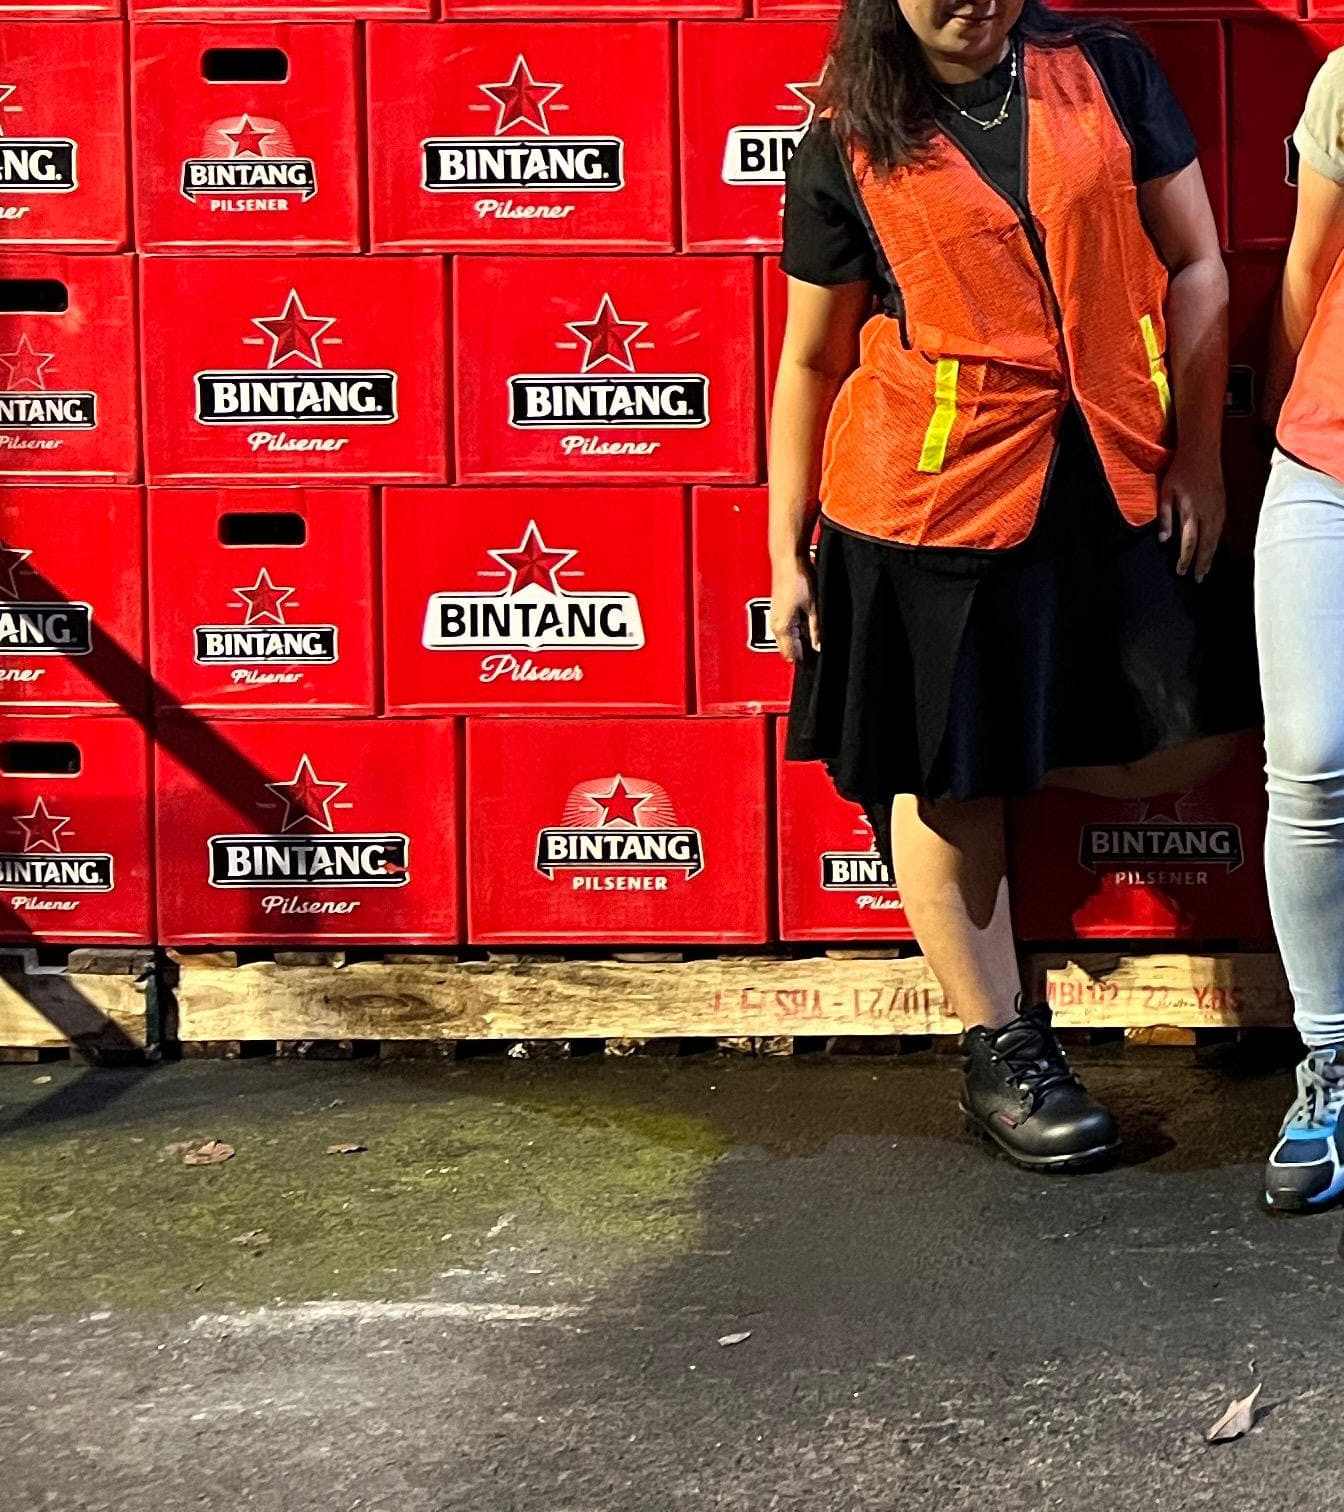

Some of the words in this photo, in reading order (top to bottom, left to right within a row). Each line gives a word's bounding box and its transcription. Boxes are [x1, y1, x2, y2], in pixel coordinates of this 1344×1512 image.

[210, 199, 288, 212] PILSENER
[474, 199, 574, 221] Pilsener
[247, 432, 347, 454] Pilsener
[443, 603, 626, 638] BINTANG
[573, 876, 667, 892] PILSENER
[261, 894, 359, 915] Pilsener
